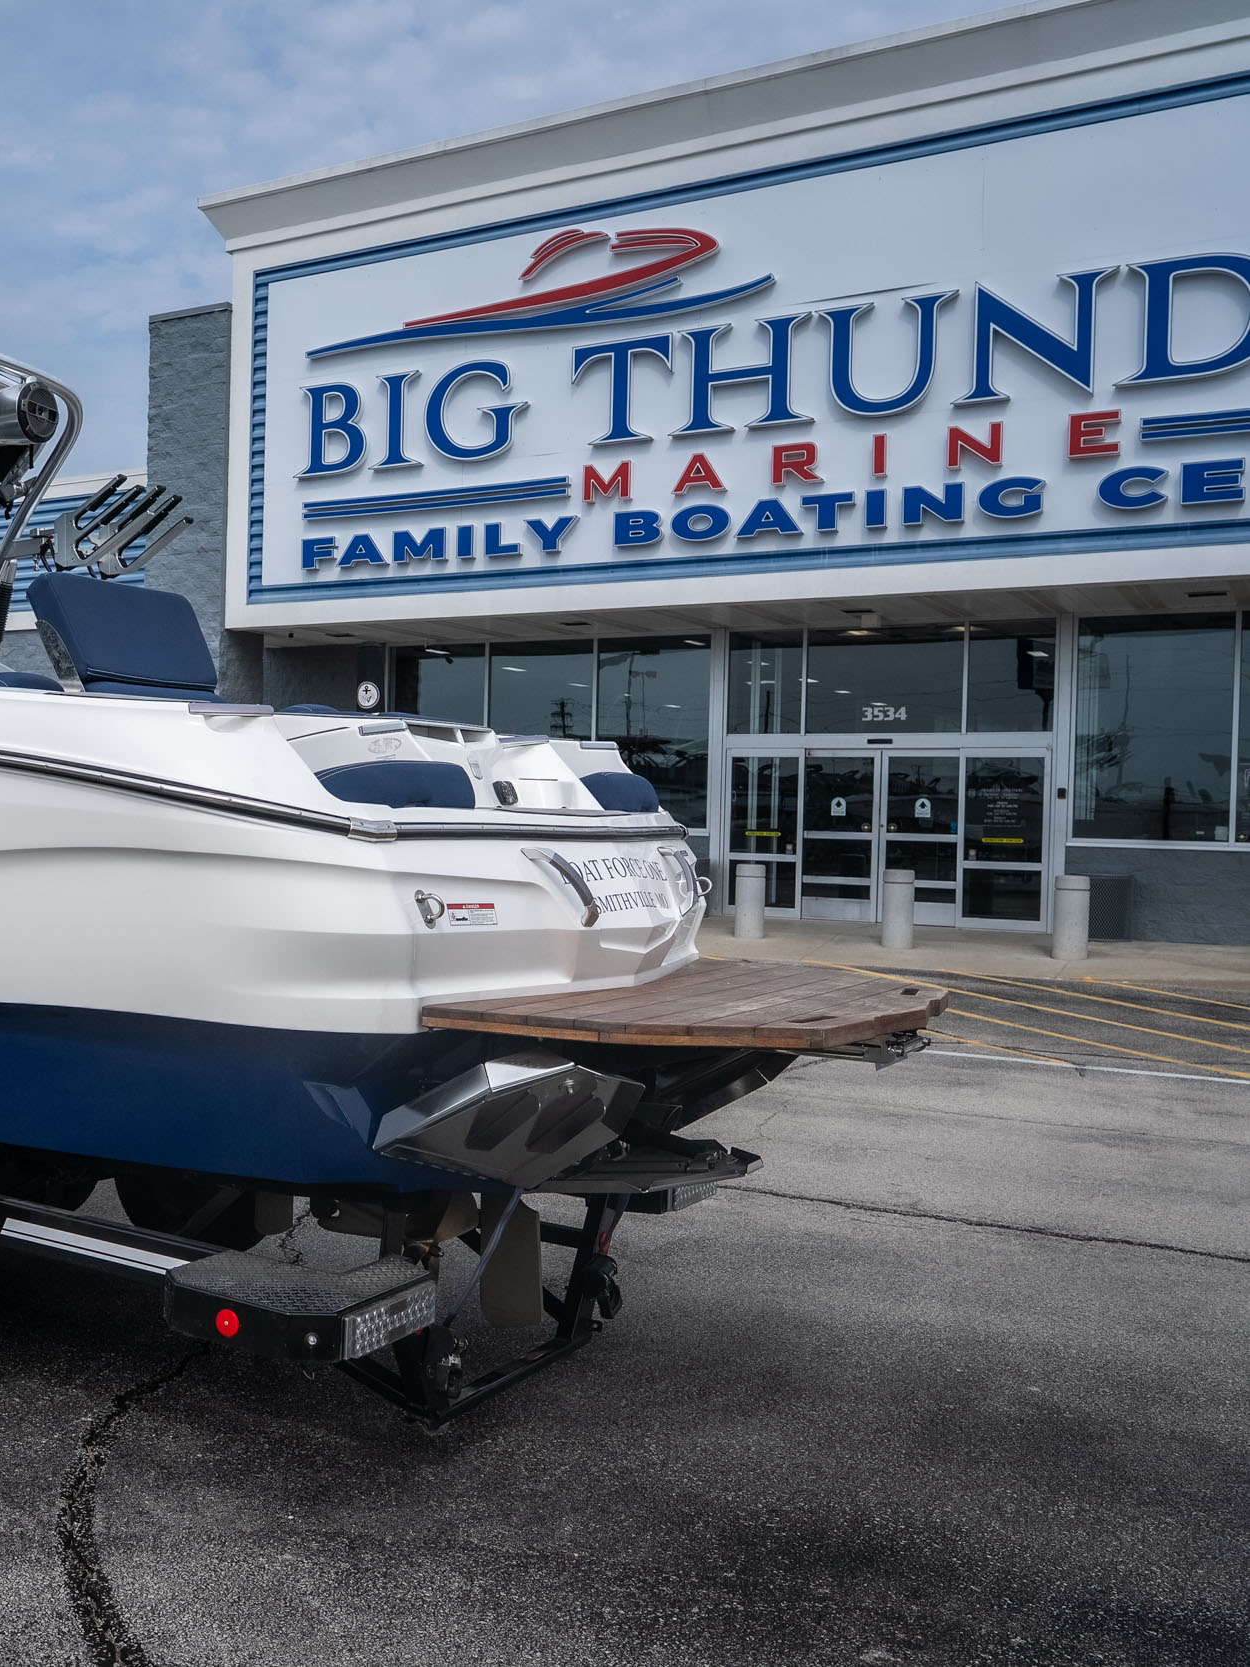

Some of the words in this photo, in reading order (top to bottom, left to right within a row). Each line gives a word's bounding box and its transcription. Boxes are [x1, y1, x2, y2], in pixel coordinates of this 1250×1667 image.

[293, 359, 530, 480] BIG
[571, 252, 1250, 447] THUND
[582, 408, 1122, 504] MARINE
[301, 514, 580, 571] FAMILY
[613, 475, 1048, 547] BOATING
[1096, 457, 1247, 511] CE
[861, 706, 908, 721] 3534
[600, 856, 648, 880] FORCE
[641, 859, 669, 882] ONE
